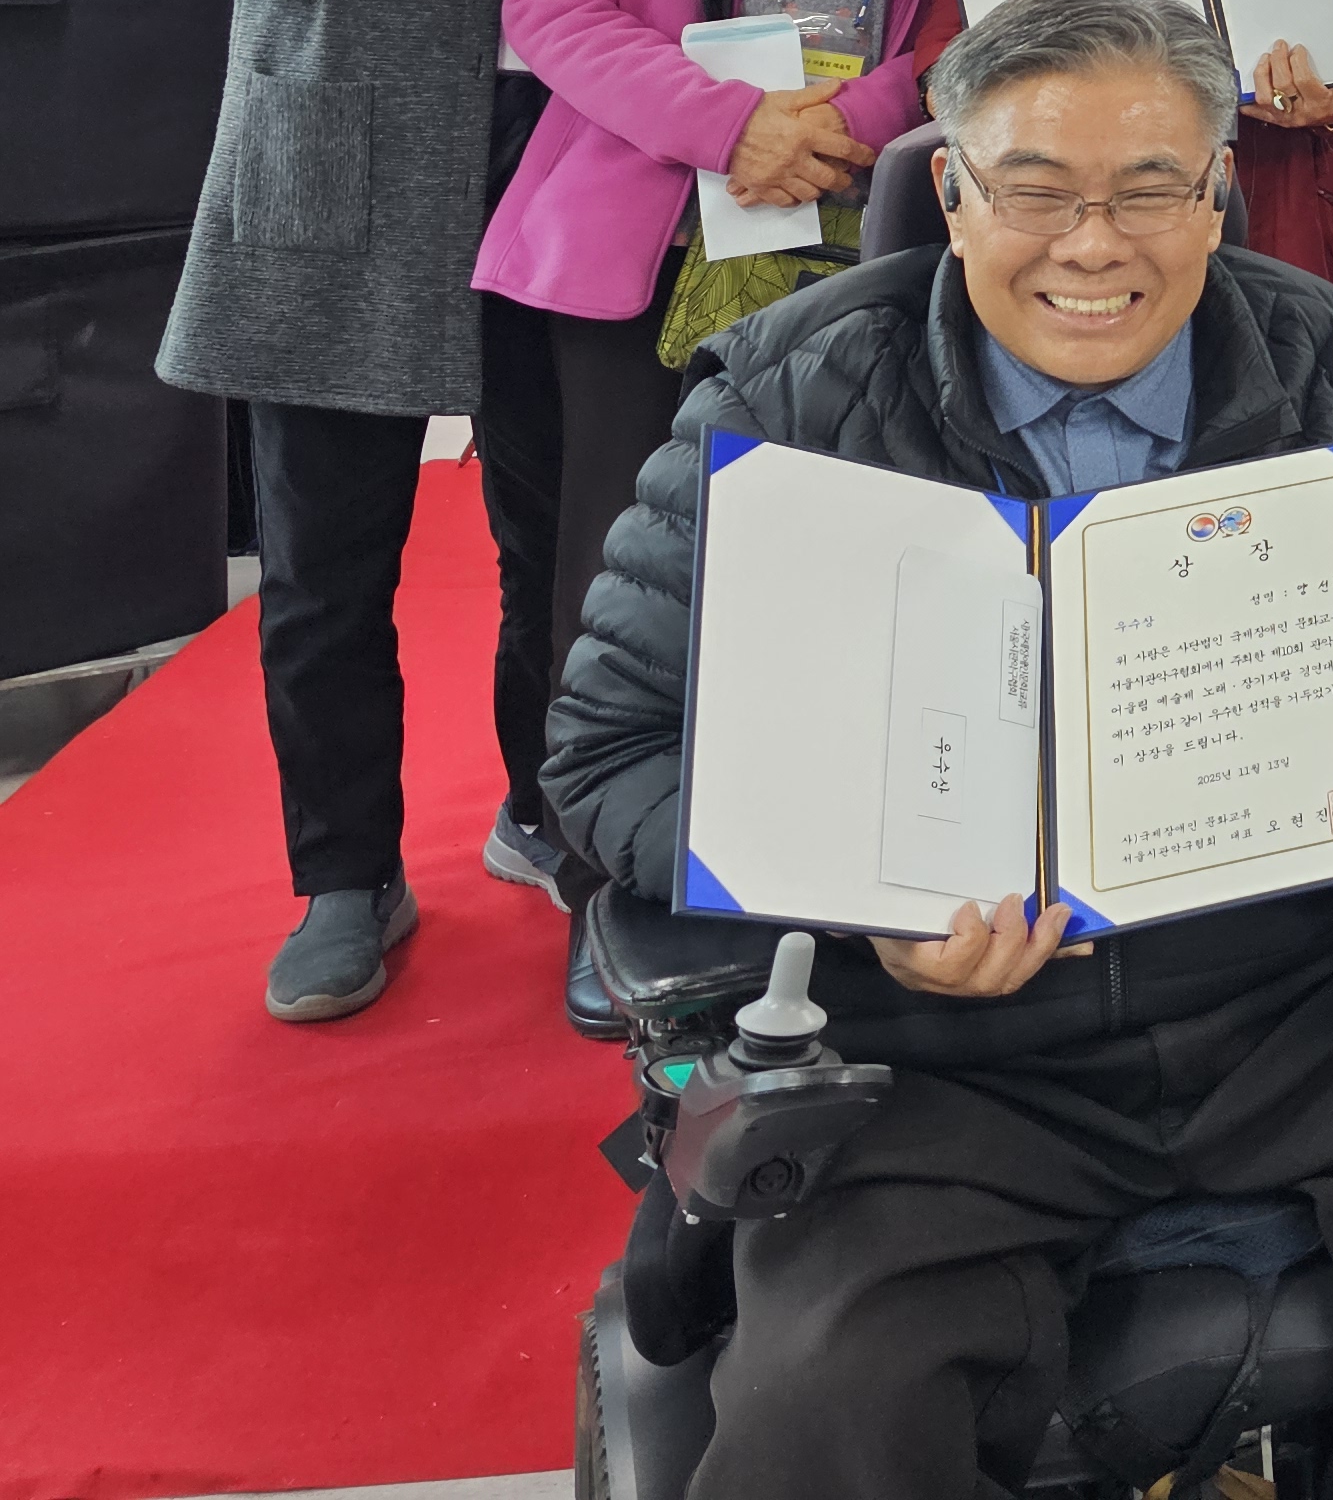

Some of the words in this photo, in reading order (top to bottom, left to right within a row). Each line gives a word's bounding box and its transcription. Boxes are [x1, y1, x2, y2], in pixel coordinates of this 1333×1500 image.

[1168, 555, 1194, 578] 상
[1249, 539, 1273, 561] 장
[1115, 616, 1153, 631] 우수상
[931, 736, 951, 794] 우수상
[1198, 769, 1230, 785] 2025년
[1239, 763, 1259, 776] 11월
[1268, 756, 1288, 770] 13일
